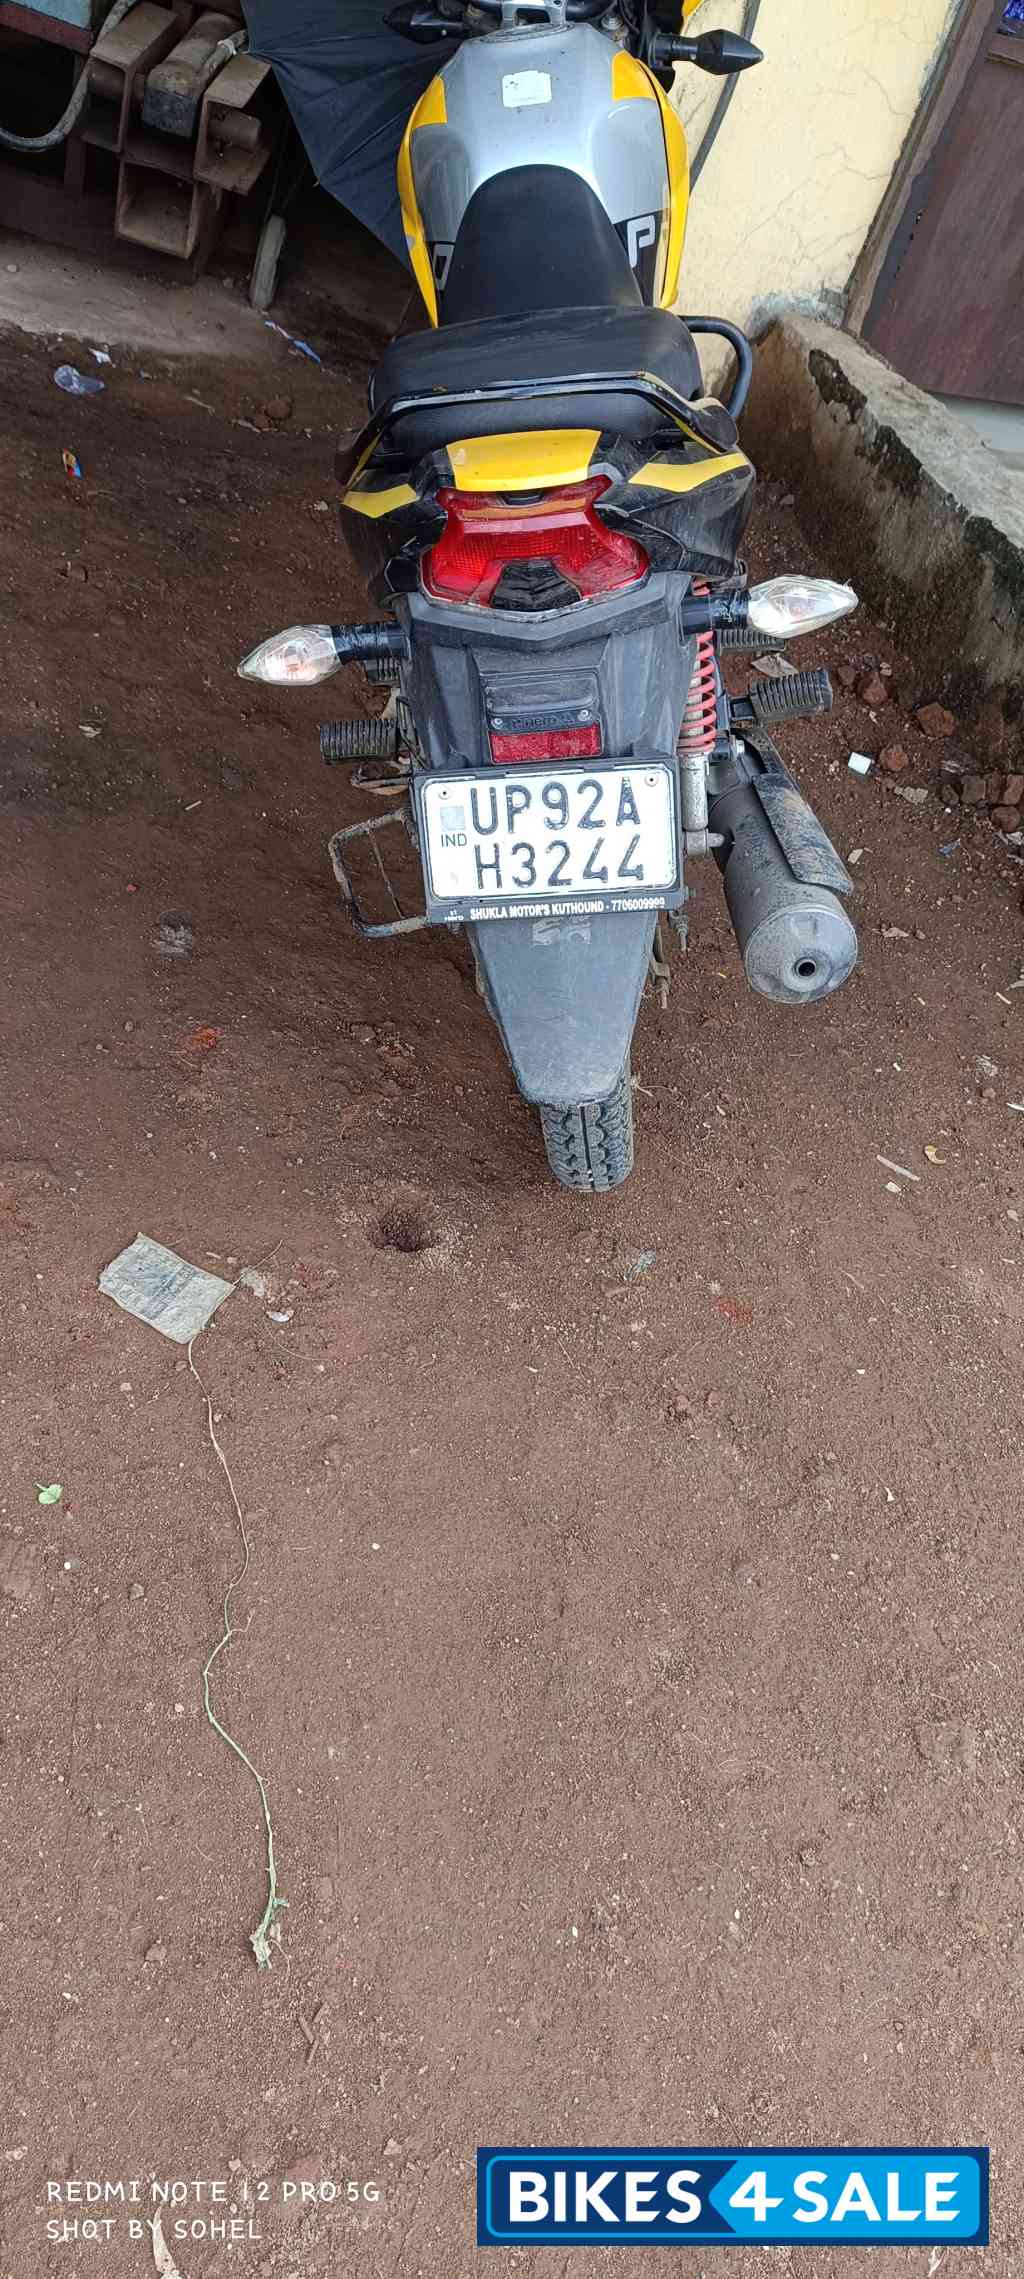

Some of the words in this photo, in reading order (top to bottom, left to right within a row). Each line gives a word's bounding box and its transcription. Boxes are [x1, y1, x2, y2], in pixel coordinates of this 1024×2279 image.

[470, 776, 641, 835] UP92A
[441, 833, 467, 847] IND
[474, 834, 644, 889] H3244
[470, 905, 509, 920] SHUKLA
[509, 902, 550, 917] MOTOR'S
[552, 900, 604, 915] KUTHOUND
